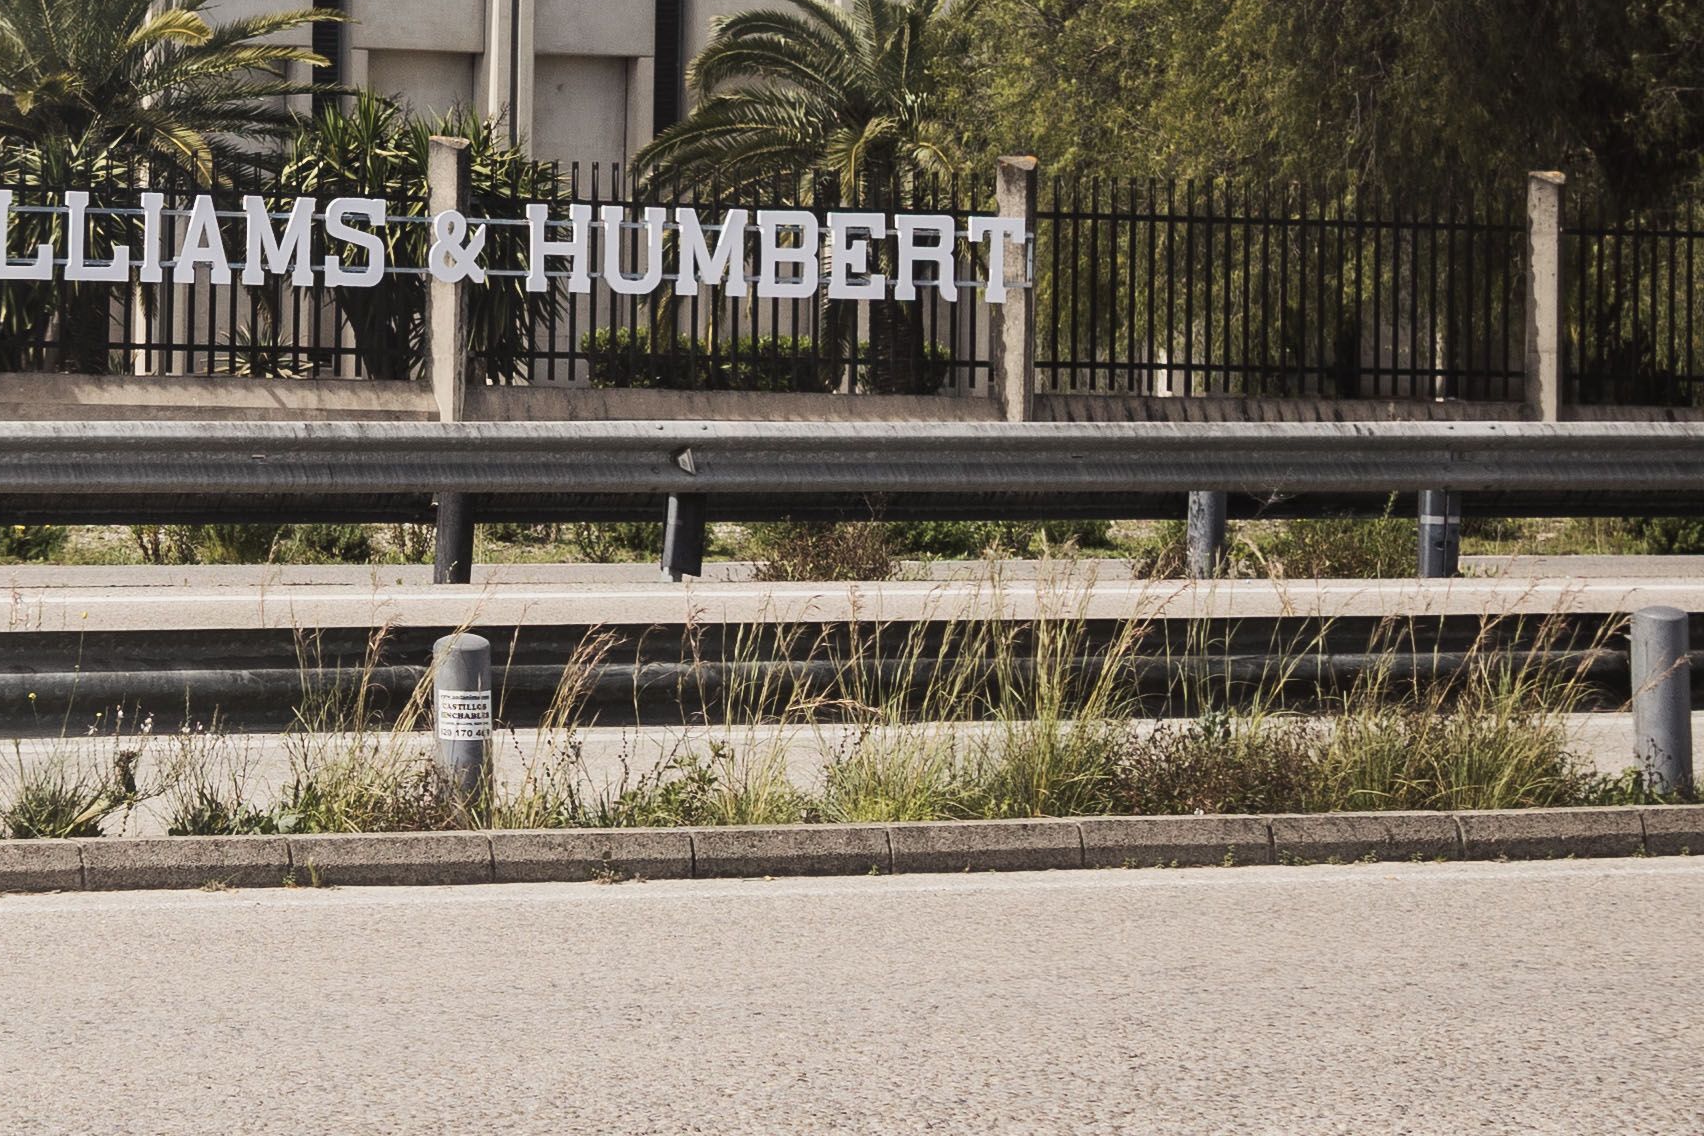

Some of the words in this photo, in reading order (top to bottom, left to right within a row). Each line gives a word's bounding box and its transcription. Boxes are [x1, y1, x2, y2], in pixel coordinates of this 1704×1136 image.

[428, 210, 486, 283] &
[525, 203, 1027, 304] HUMBERT
[441, 703, 488, 711] CASTILLOS
[455, 729, 473, 737] 170
